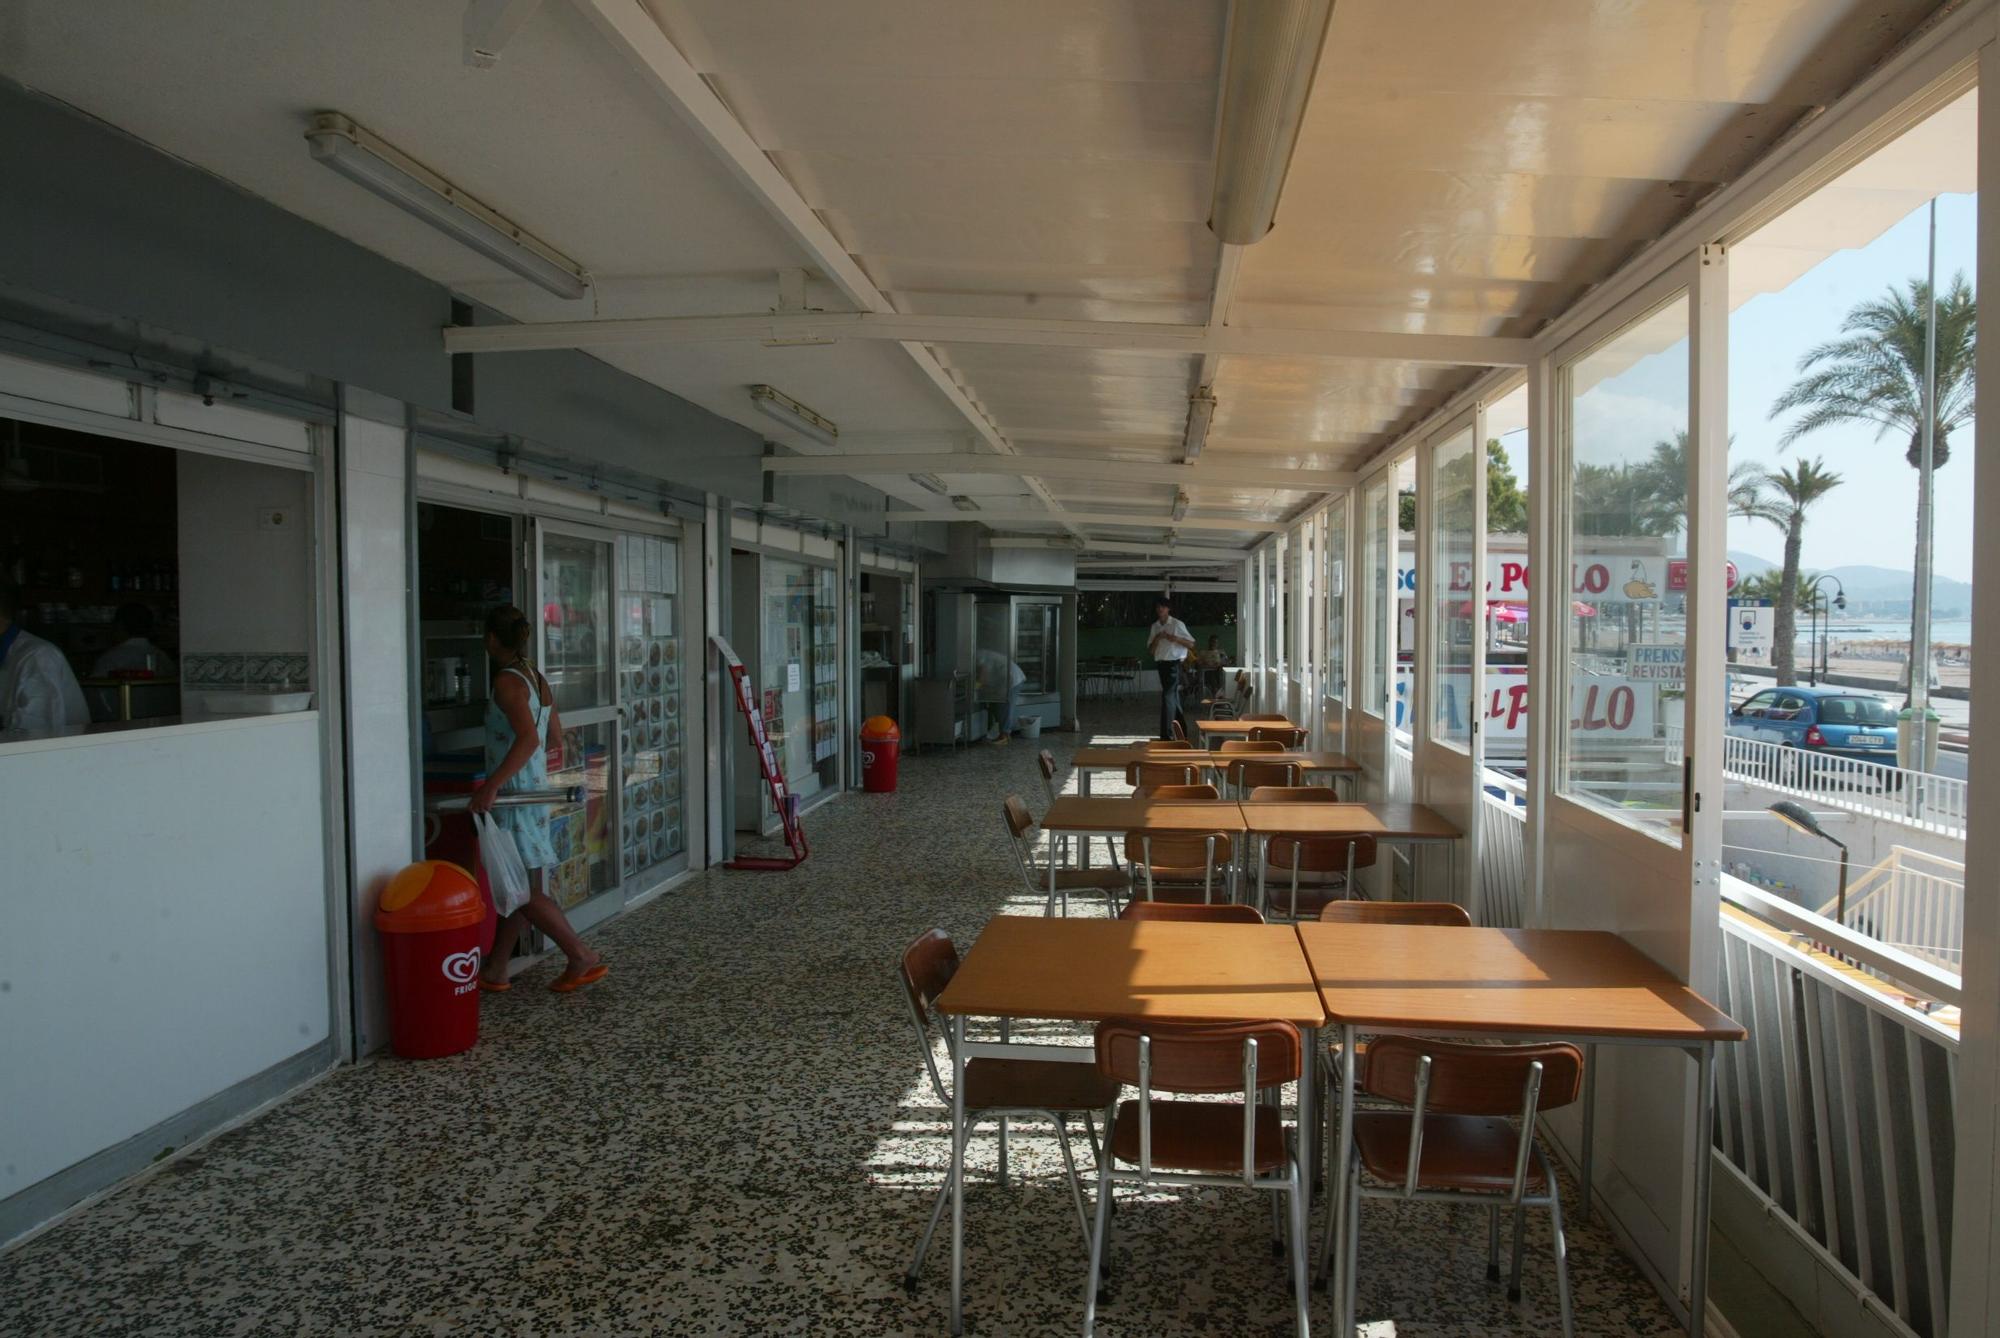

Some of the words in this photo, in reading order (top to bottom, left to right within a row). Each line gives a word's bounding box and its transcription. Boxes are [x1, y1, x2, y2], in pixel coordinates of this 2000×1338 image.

[1501, 562, 1610, 593] PLO
[1633, 665, 1686, 678] REVISTA
[1507, 685, 1635, 730] PLO
